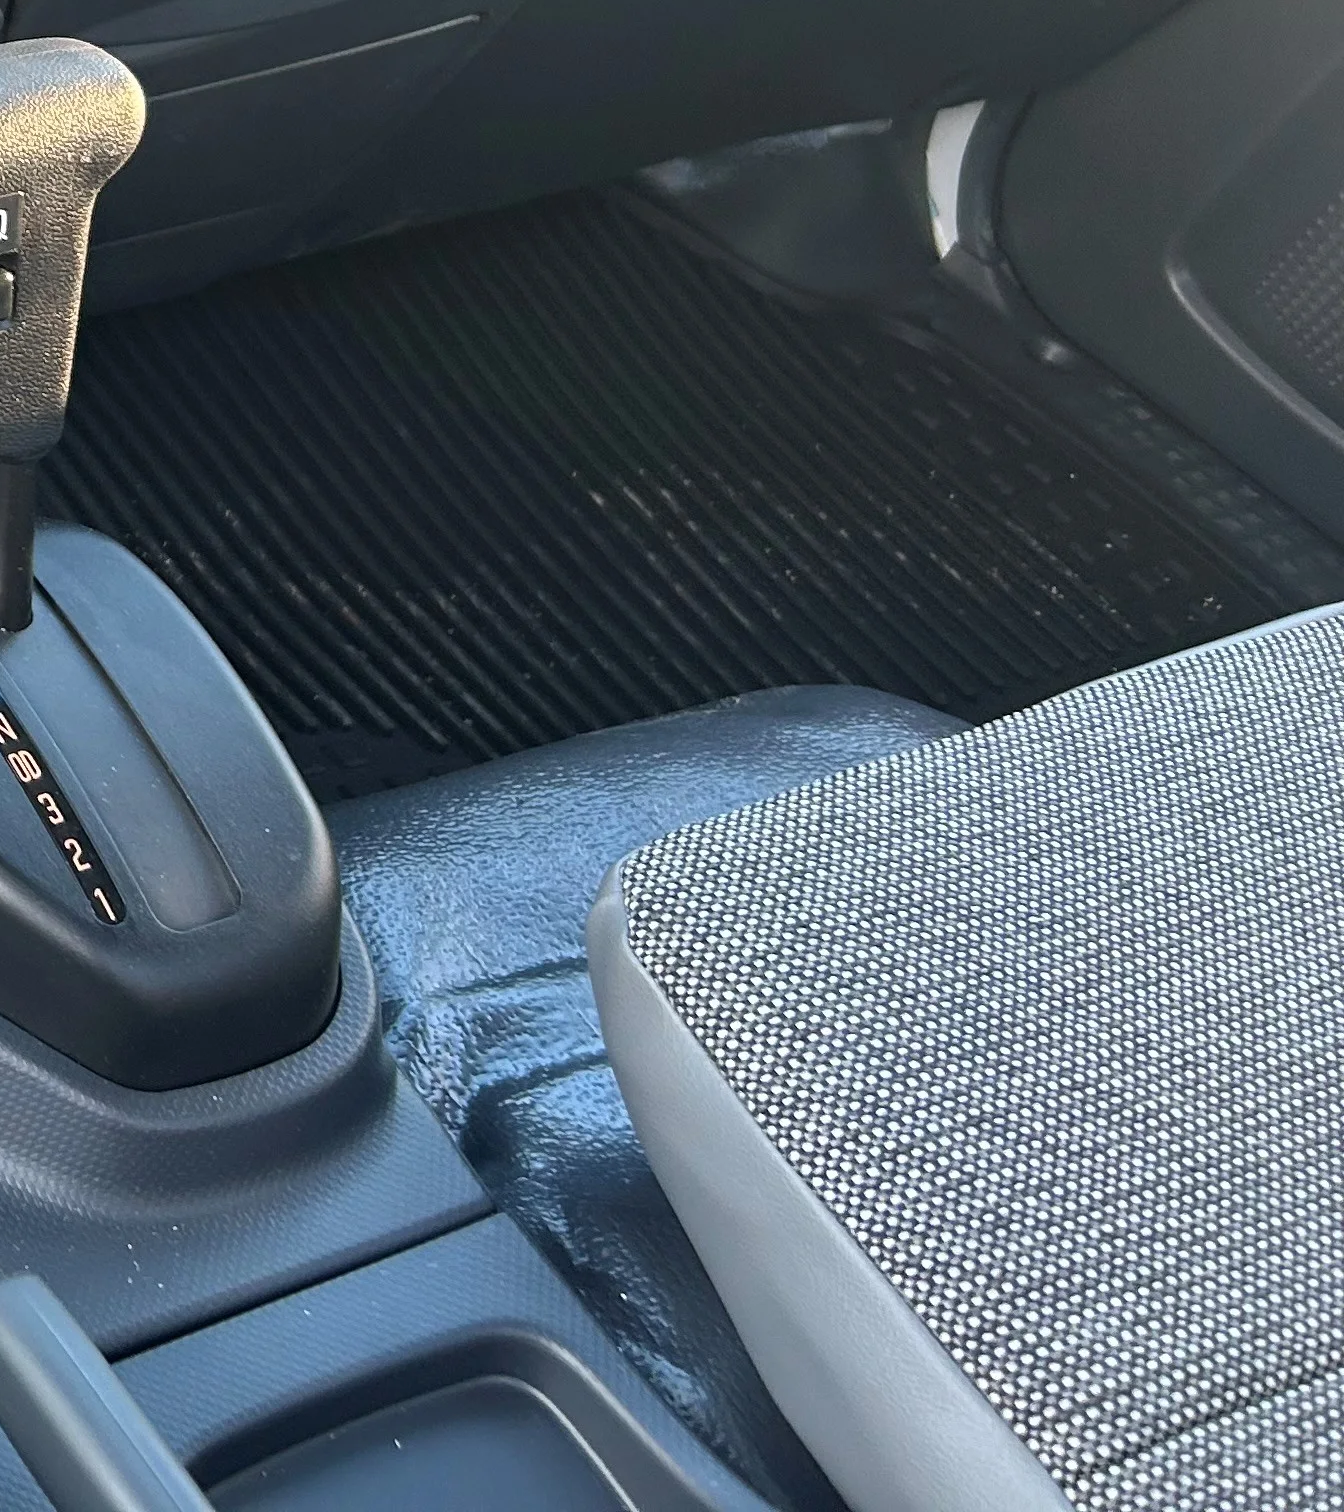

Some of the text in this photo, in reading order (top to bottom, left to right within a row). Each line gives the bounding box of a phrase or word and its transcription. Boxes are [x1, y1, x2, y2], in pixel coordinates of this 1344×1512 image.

[37, 792, 65, 826] 3
[64, 838, 92, 872] 2
[93, 887, 117, 922] 1
